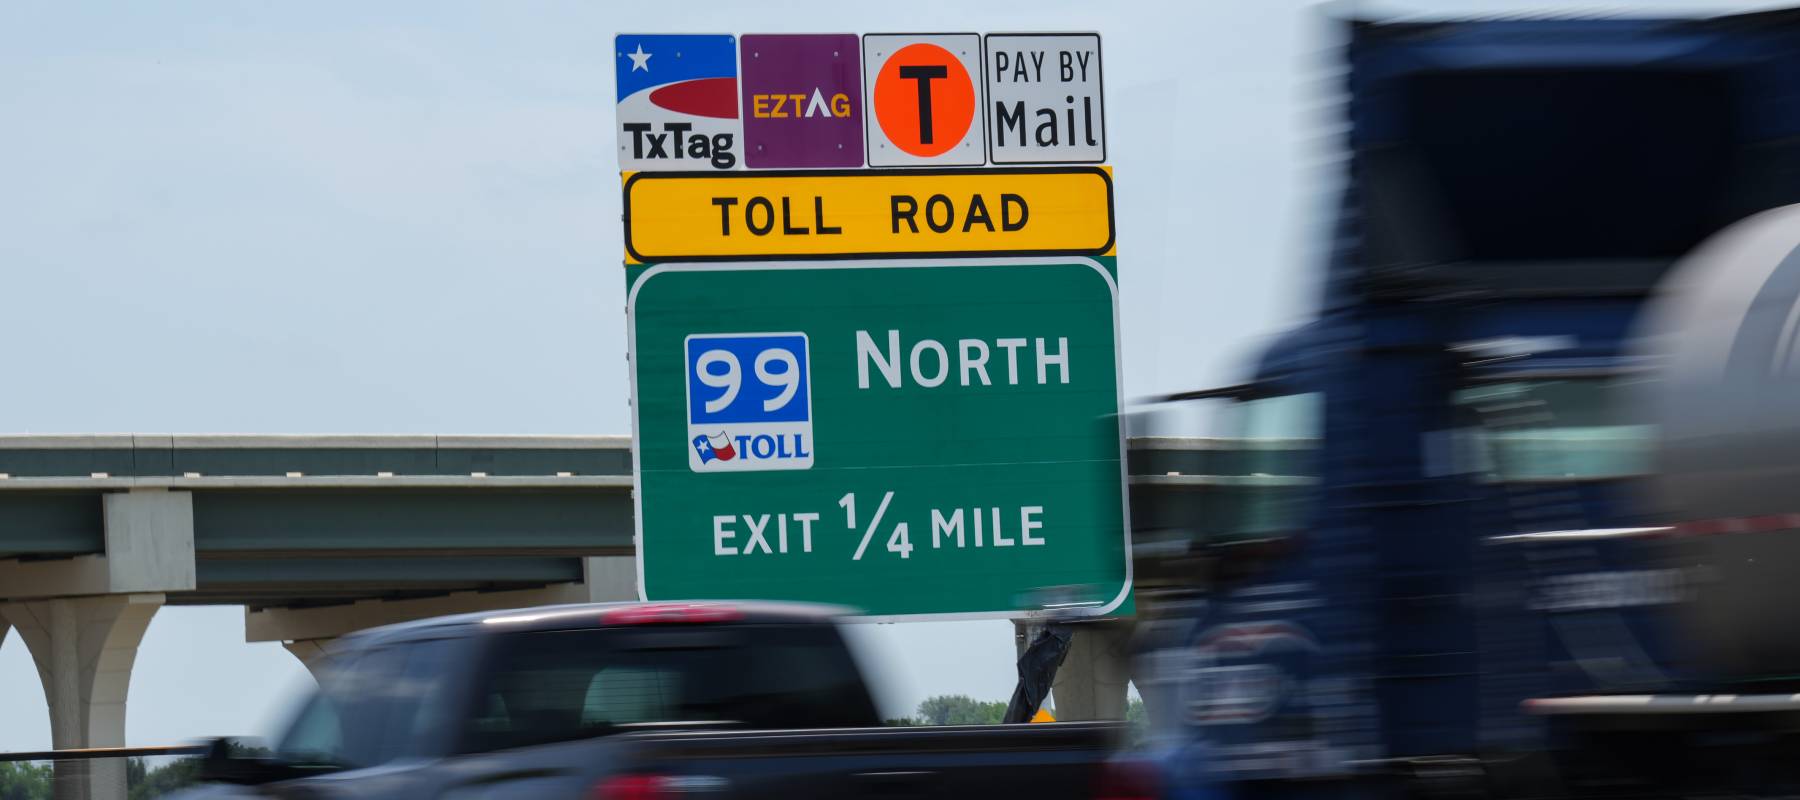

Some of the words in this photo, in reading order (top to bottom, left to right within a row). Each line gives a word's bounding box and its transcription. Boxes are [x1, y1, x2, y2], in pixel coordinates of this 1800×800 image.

[996, 51, 1045, 83] PAY
[1060, 51, 1091, 82] BY
[900, 65, 947, 145] T
[997, 96, 1097, 147] Mail
[623, 122, 736, 168] TxTag
[712, 196, 842, 236] TOLL
[891, 193, 1029, 234] ROAD
[696, 348, 800, 413] 99
[734, 433, 810, 459] TOLL
[713, 512, 820, 556] EXIT
[931, 506, 1046, 550] MILE
